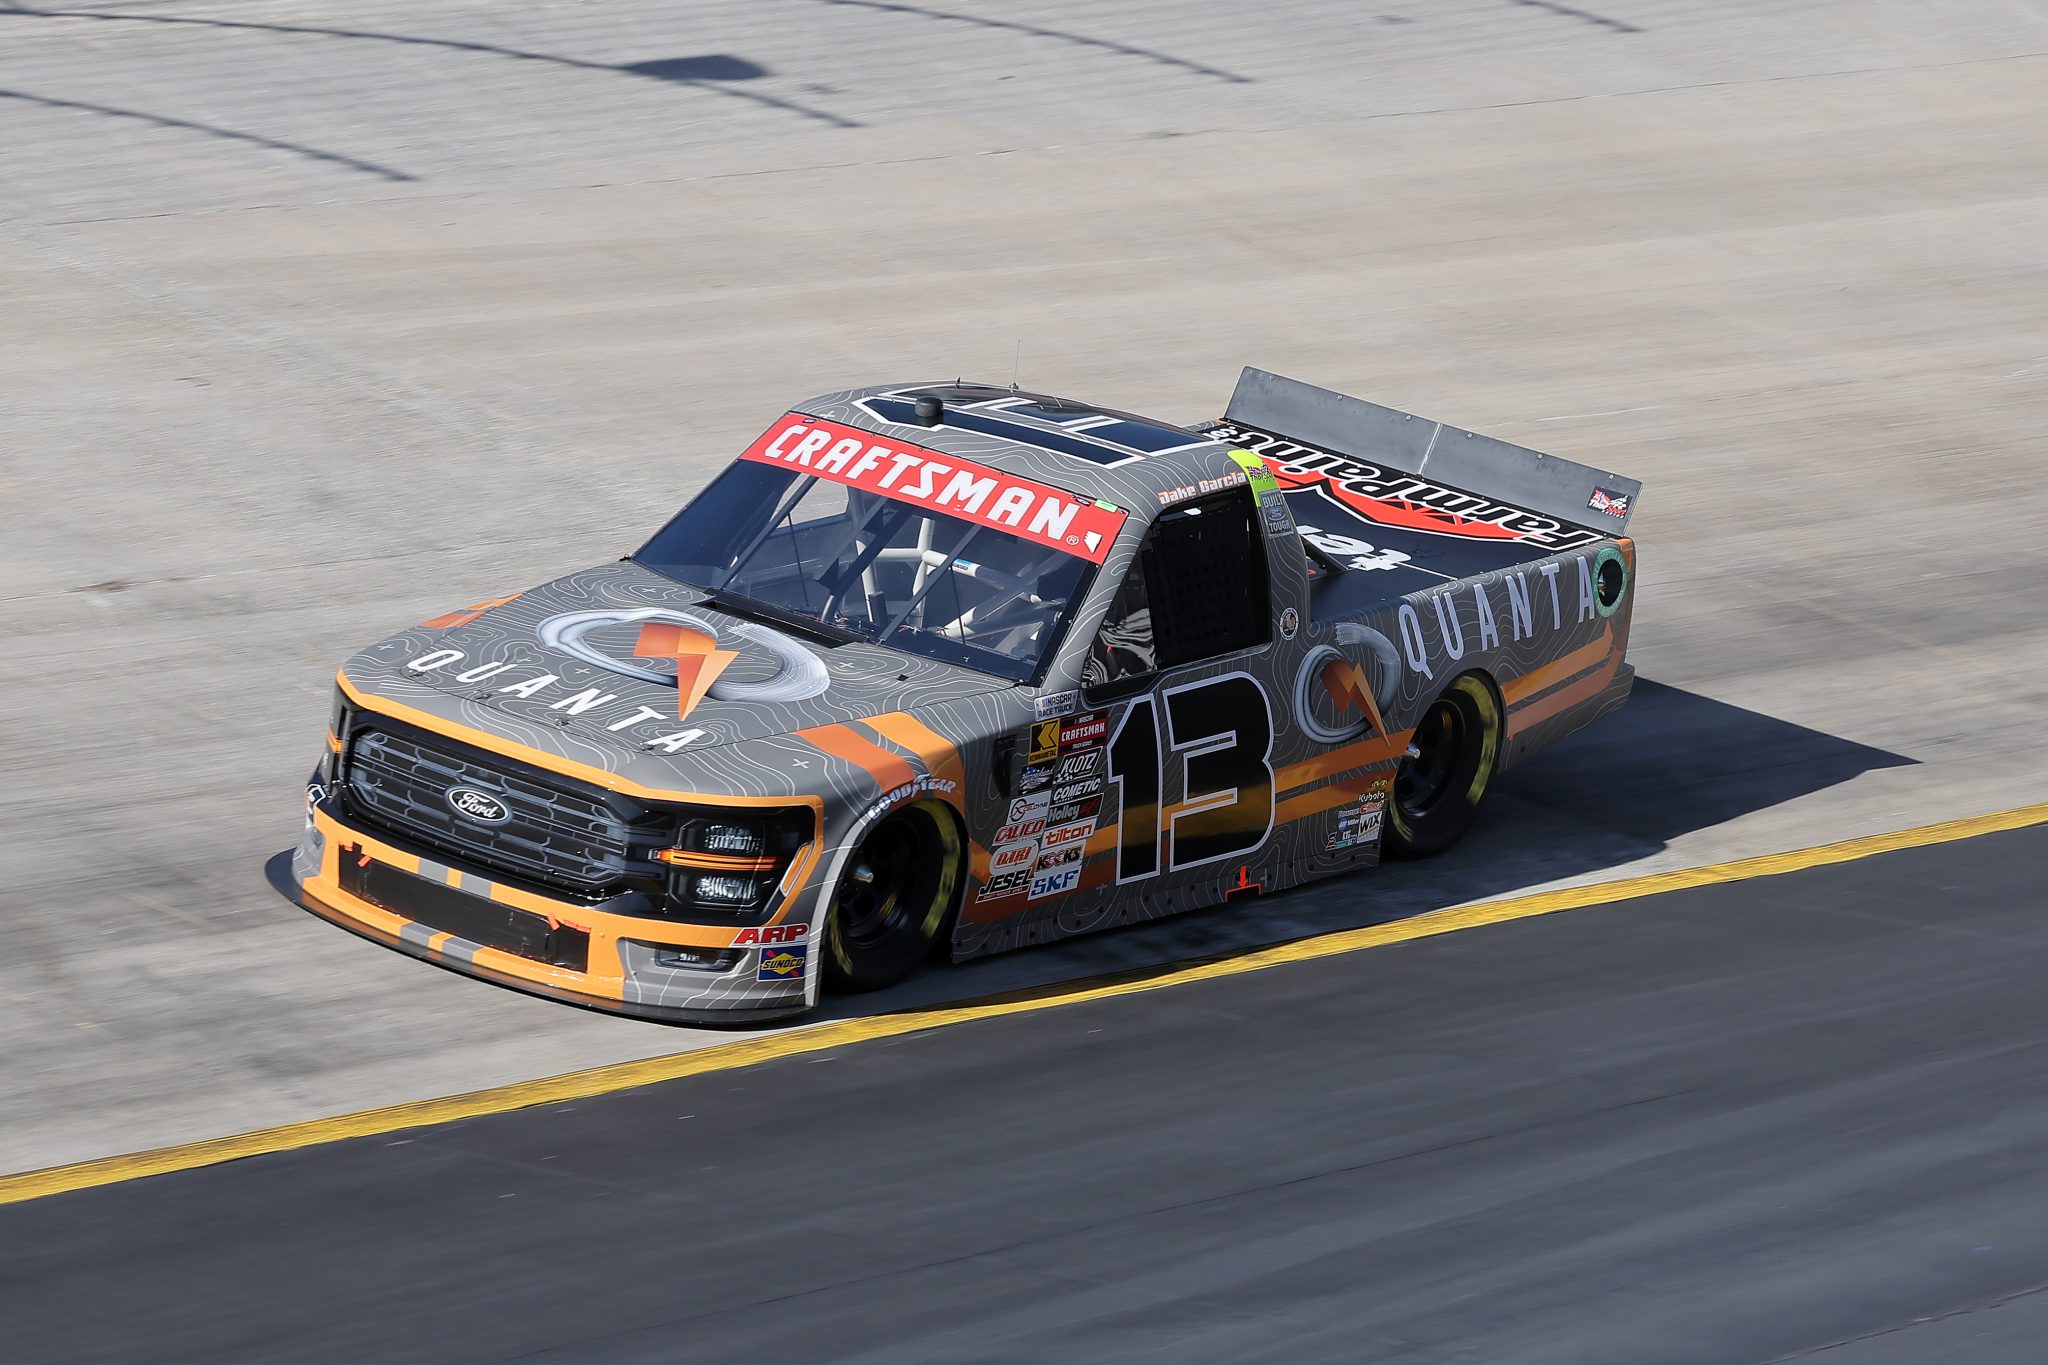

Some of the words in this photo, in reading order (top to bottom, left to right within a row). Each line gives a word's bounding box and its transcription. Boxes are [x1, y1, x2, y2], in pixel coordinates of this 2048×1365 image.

[764, 425, 1080, 541] CRAFTSMAN
[1158, 485, 1197, 505] Jake
[1262, 495, 1283, 509] BUILT
[1268, 519, 1290, 533] TOUGH
[1400, 555, 1595, 679] QUANTA
[407, 649, 706, 752] QUANTA
[1038, 706, 1054, 717] RACE
[1054, 703, 1073, 714] TRUCK
[1046, 693, 1072, 706] NASCAR
[1061, 722, 1105, 742] CRAFTSMAN
[1061, 752, 1096, 775] KLOTZ
[1053, 778, 1101, 801] COMETIC
[1107, 671, 1276, 886] 13
[457, 791, 499, 819] Ford
[1358, 790, 1385, 803] Kubota
[1048, 804, 1080, 822] Holley
[1360, 813, 1380, 834] WIX
[995, 819, 1046, 843] CALICO
[1046, 823, 1093, 845] tilton
[1037, 845, 1082, 870] KOOKS
[980, 868, 1032, 895] JESEL
[1031, 869, 1079, 897] SKF
[735, 924, 809, 944] ARP
[763, 957, 805, 969] SUNOCO
